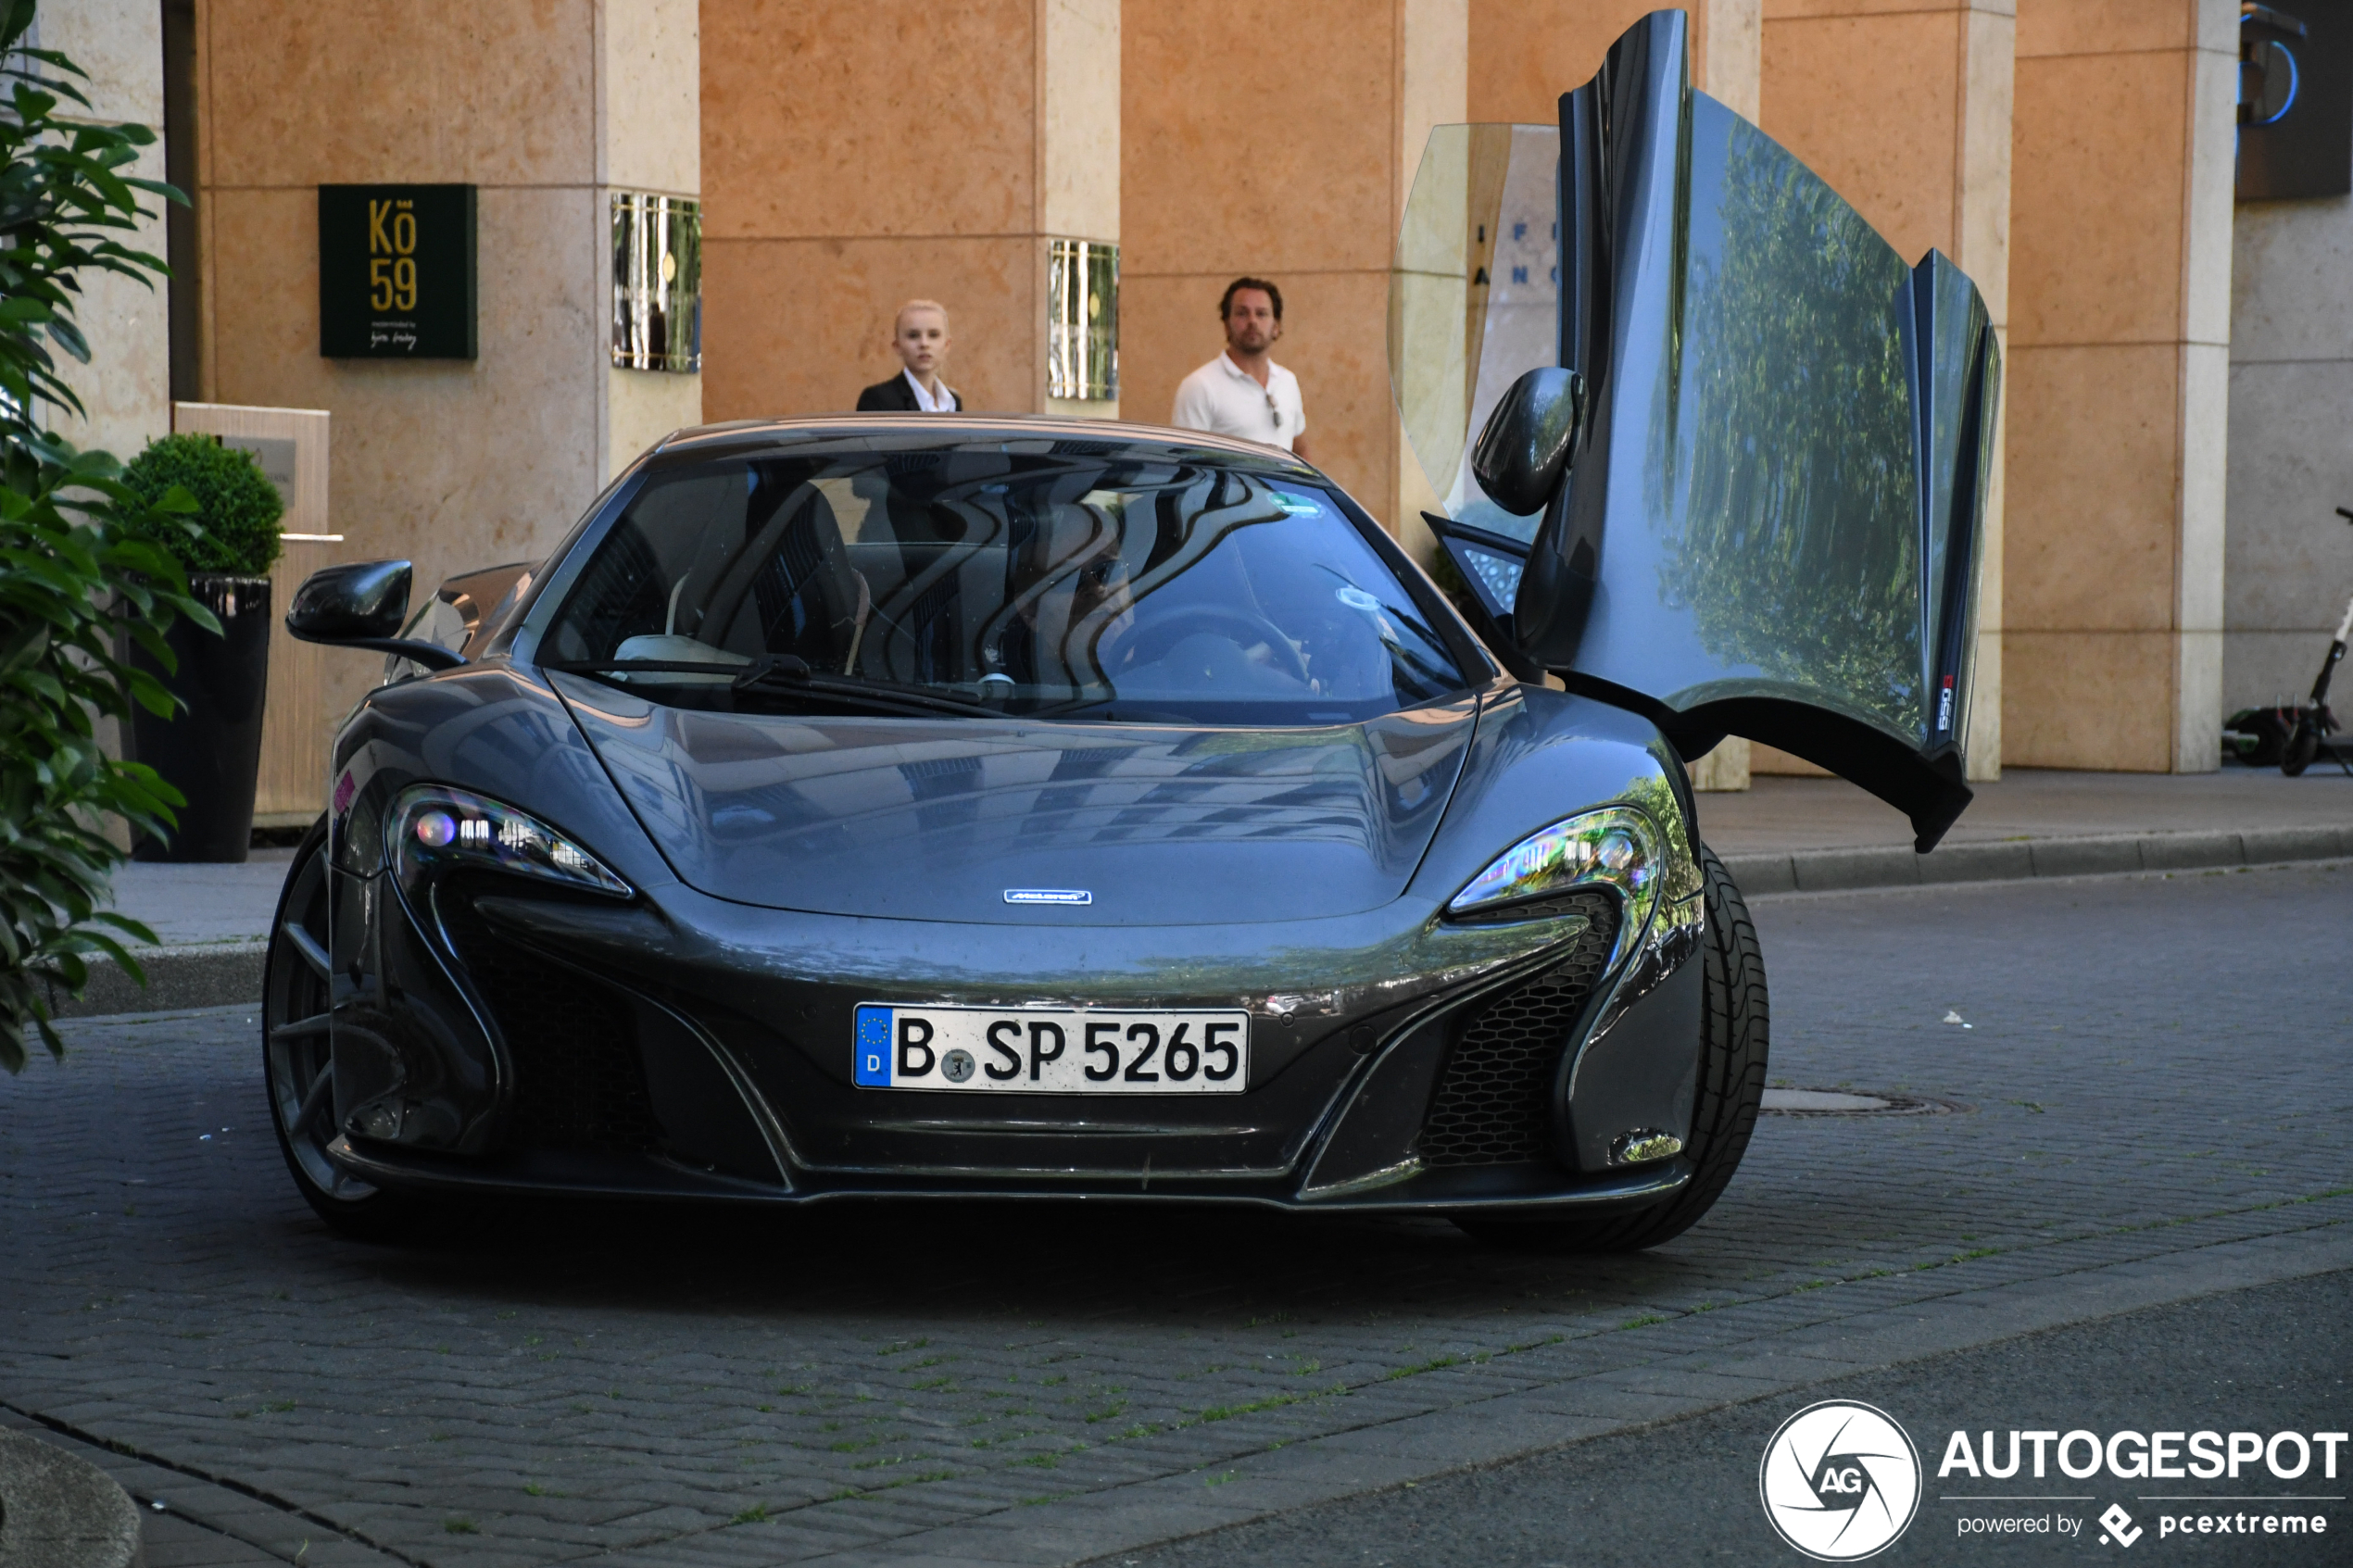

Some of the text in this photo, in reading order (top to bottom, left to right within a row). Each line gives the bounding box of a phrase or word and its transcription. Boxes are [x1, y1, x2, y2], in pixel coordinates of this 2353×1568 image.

[371, 257, 416, 311] 59
[867, 1054, 880, 1072] D
[898, 1017, 1239, 1083] B SP 5265
